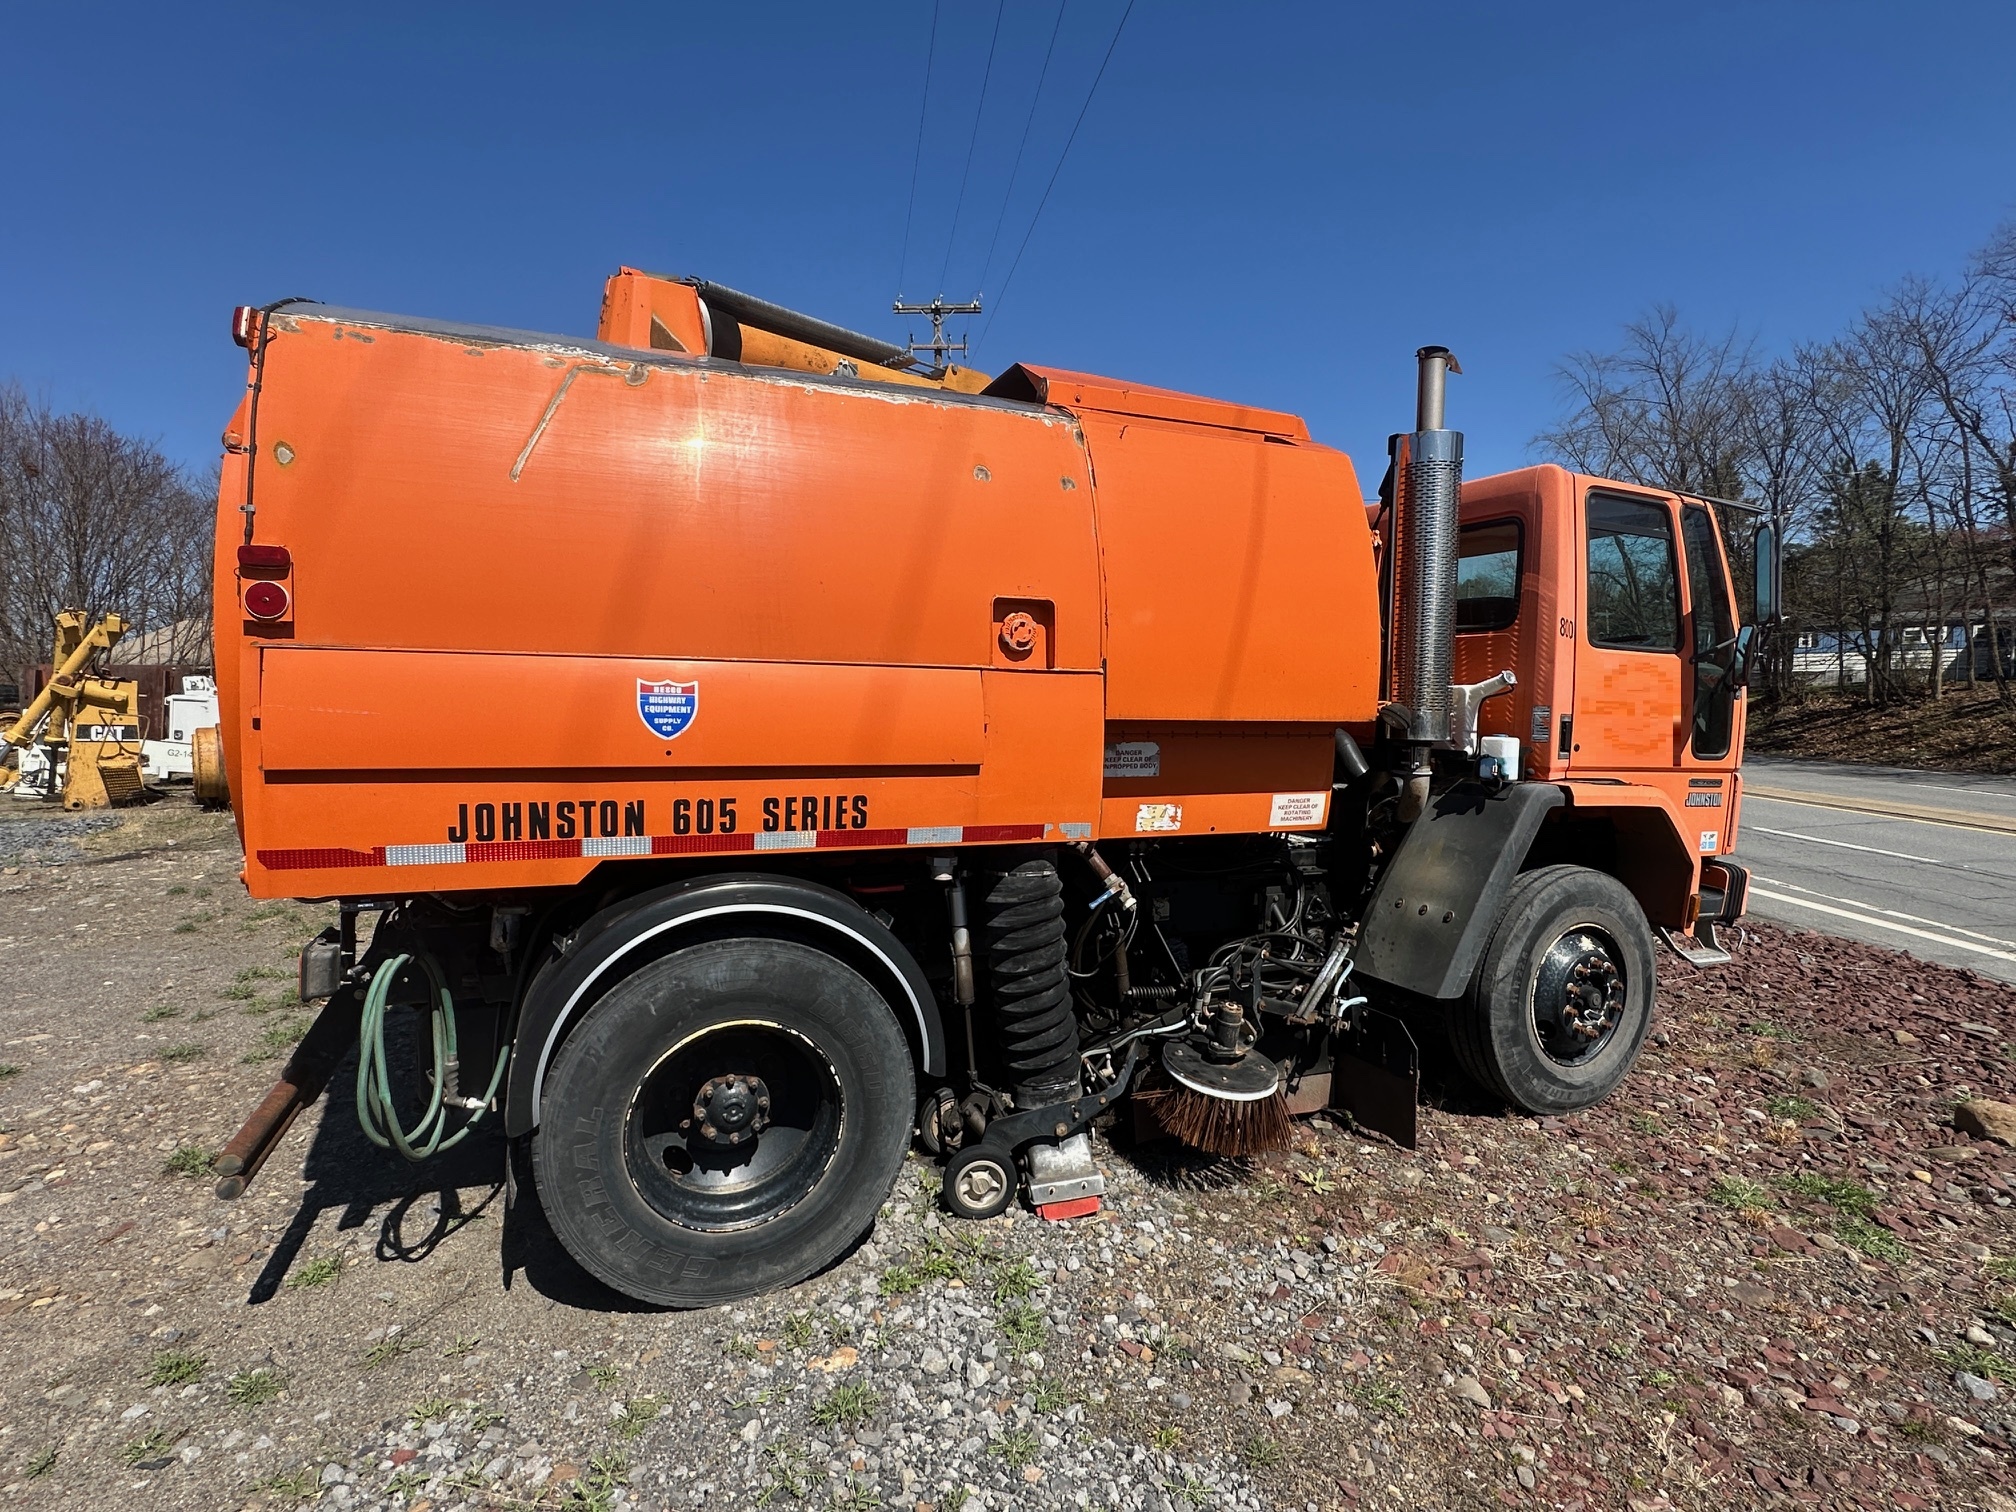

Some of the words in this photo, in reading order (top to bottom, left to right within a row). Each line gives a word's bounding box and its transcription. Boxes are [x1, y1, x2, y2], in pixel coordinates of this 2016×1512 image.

[649, 696, 686, 704] HIGHWAY
[644, 705, 691, 713] EQUIPMENT
[90, 725, 124, 741] CAT
[1685, 793, 1722, 807] JOHNSTON
[447, 800, 645, 843] JOHNSTON
[672, 798, 737, 835] 605
[763, 795, 868, 832] SERIES
[573, 1106, 720, 1279] GENERAL
